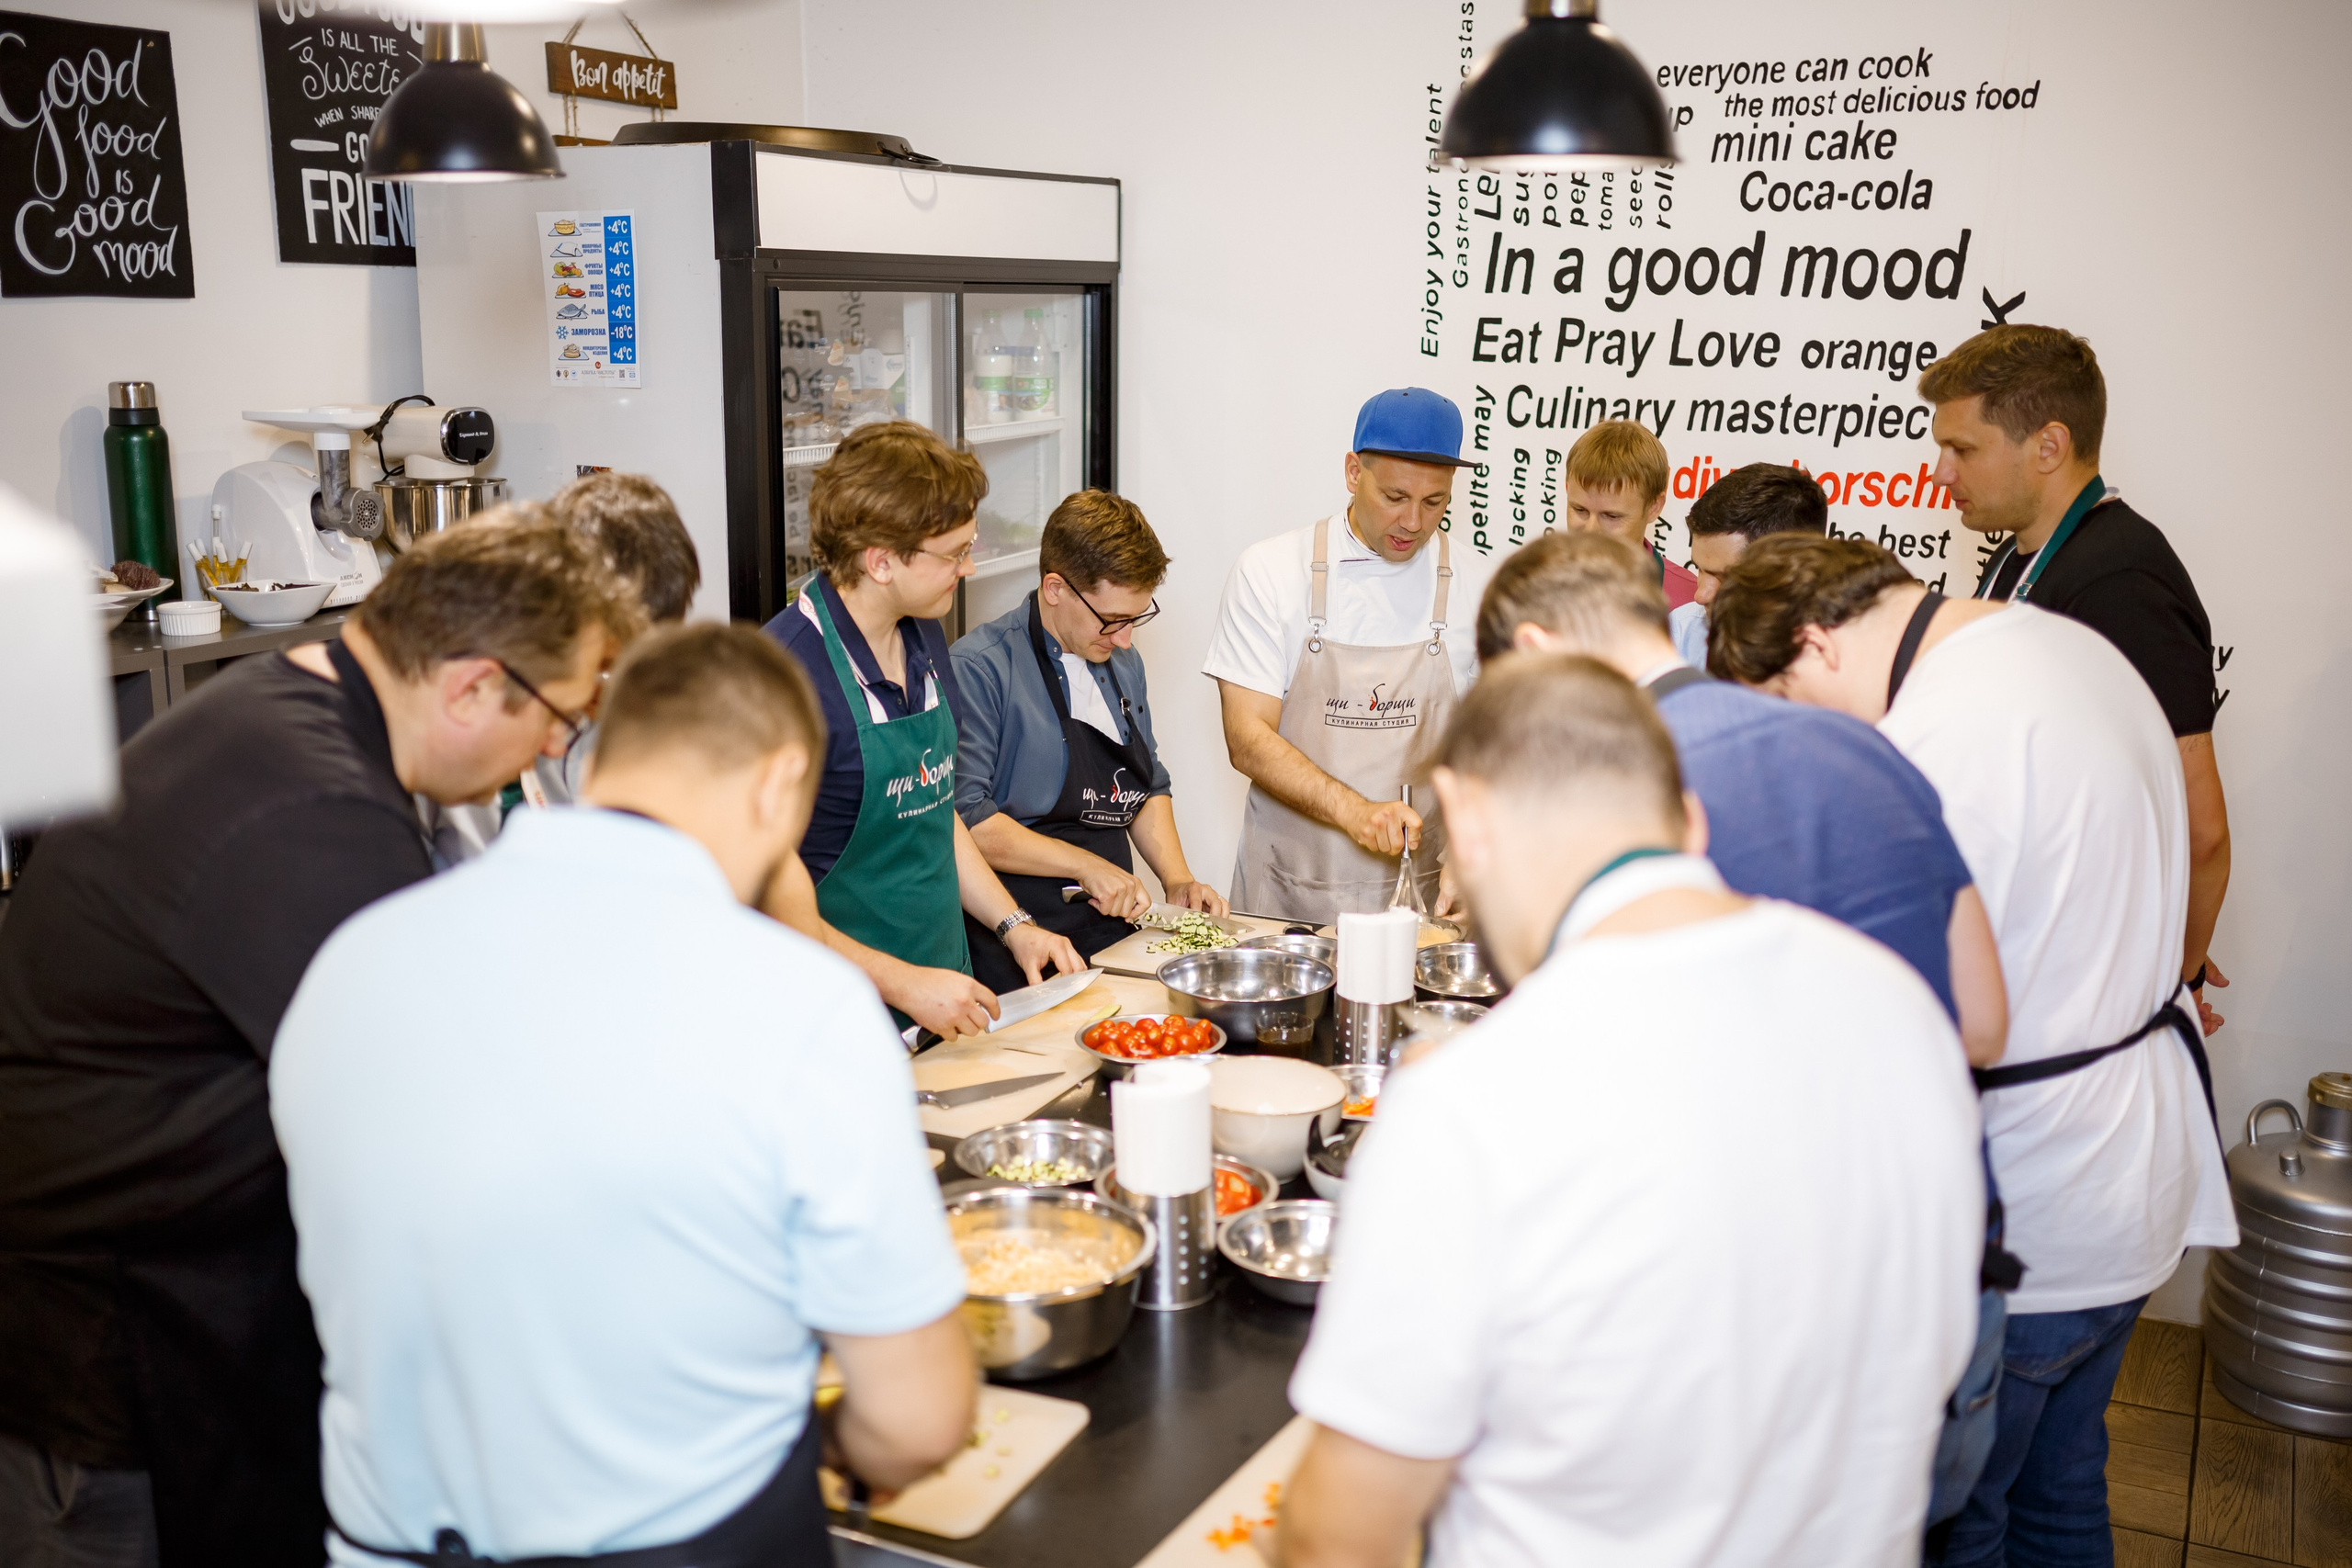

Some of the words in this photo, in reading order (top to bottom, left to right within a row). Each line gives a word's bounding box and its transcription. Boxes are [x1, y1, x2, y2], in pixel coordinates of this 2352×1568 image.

[322, 28, 336, 47] IS
[340, 31, 365, 52] ALL
[369, 35, 399, 56] THE
[570, 49, 608, 94] Bon
[612, 61, 666, 100] appetit
[1656, 62, 1786, 94] everyone
[1795, 55, 1849, 83] can
[1858, 47, 1933, 79] cook
[0, 32, 150, 200] Good
[314, 107, 344, 128] WHEN
[1724, 92, 1763, 118] the
[1771, 90, 1837, 117] most
[1843, 85, 1966, 114] delicious
[1975, 80, 2041, 110] food
[74, 104, 166, 198] food
[1425, 84, 1442, 174] talent
[1711, 121, 1794, 163] mini
[1804, 119, 1897, 161] cake
[1474, 166, 1501, 220] Le
[1739, 169, 1934, 212] Coca-cola
[1426, 185, 1444, 260] your
[93, 225, 177, 283] mood
[1485, 231, 1534, 295] In
[1554, 247, 1584, 294] a
[1605, 231, 1766, 312] good
[1781, 228, 1972, 300] mood
[571, 328, 606, 336] ЗАМОРОЗКА
[1420, 268, 1444, 357] Enjoy
[1472, 317, 1543, 364] Eat
[1555, 317, 1657, 378] Pray
[1669, 318, 1781, 368] Love
[1801, 339, 1938, 382] orange
[1474, 385, 1497, 451] may
[1507, 384, 1676, 439] Culinary
[1687, 392, 1935, 448] masterpiec
[1877, 525, 1951, 559] best
